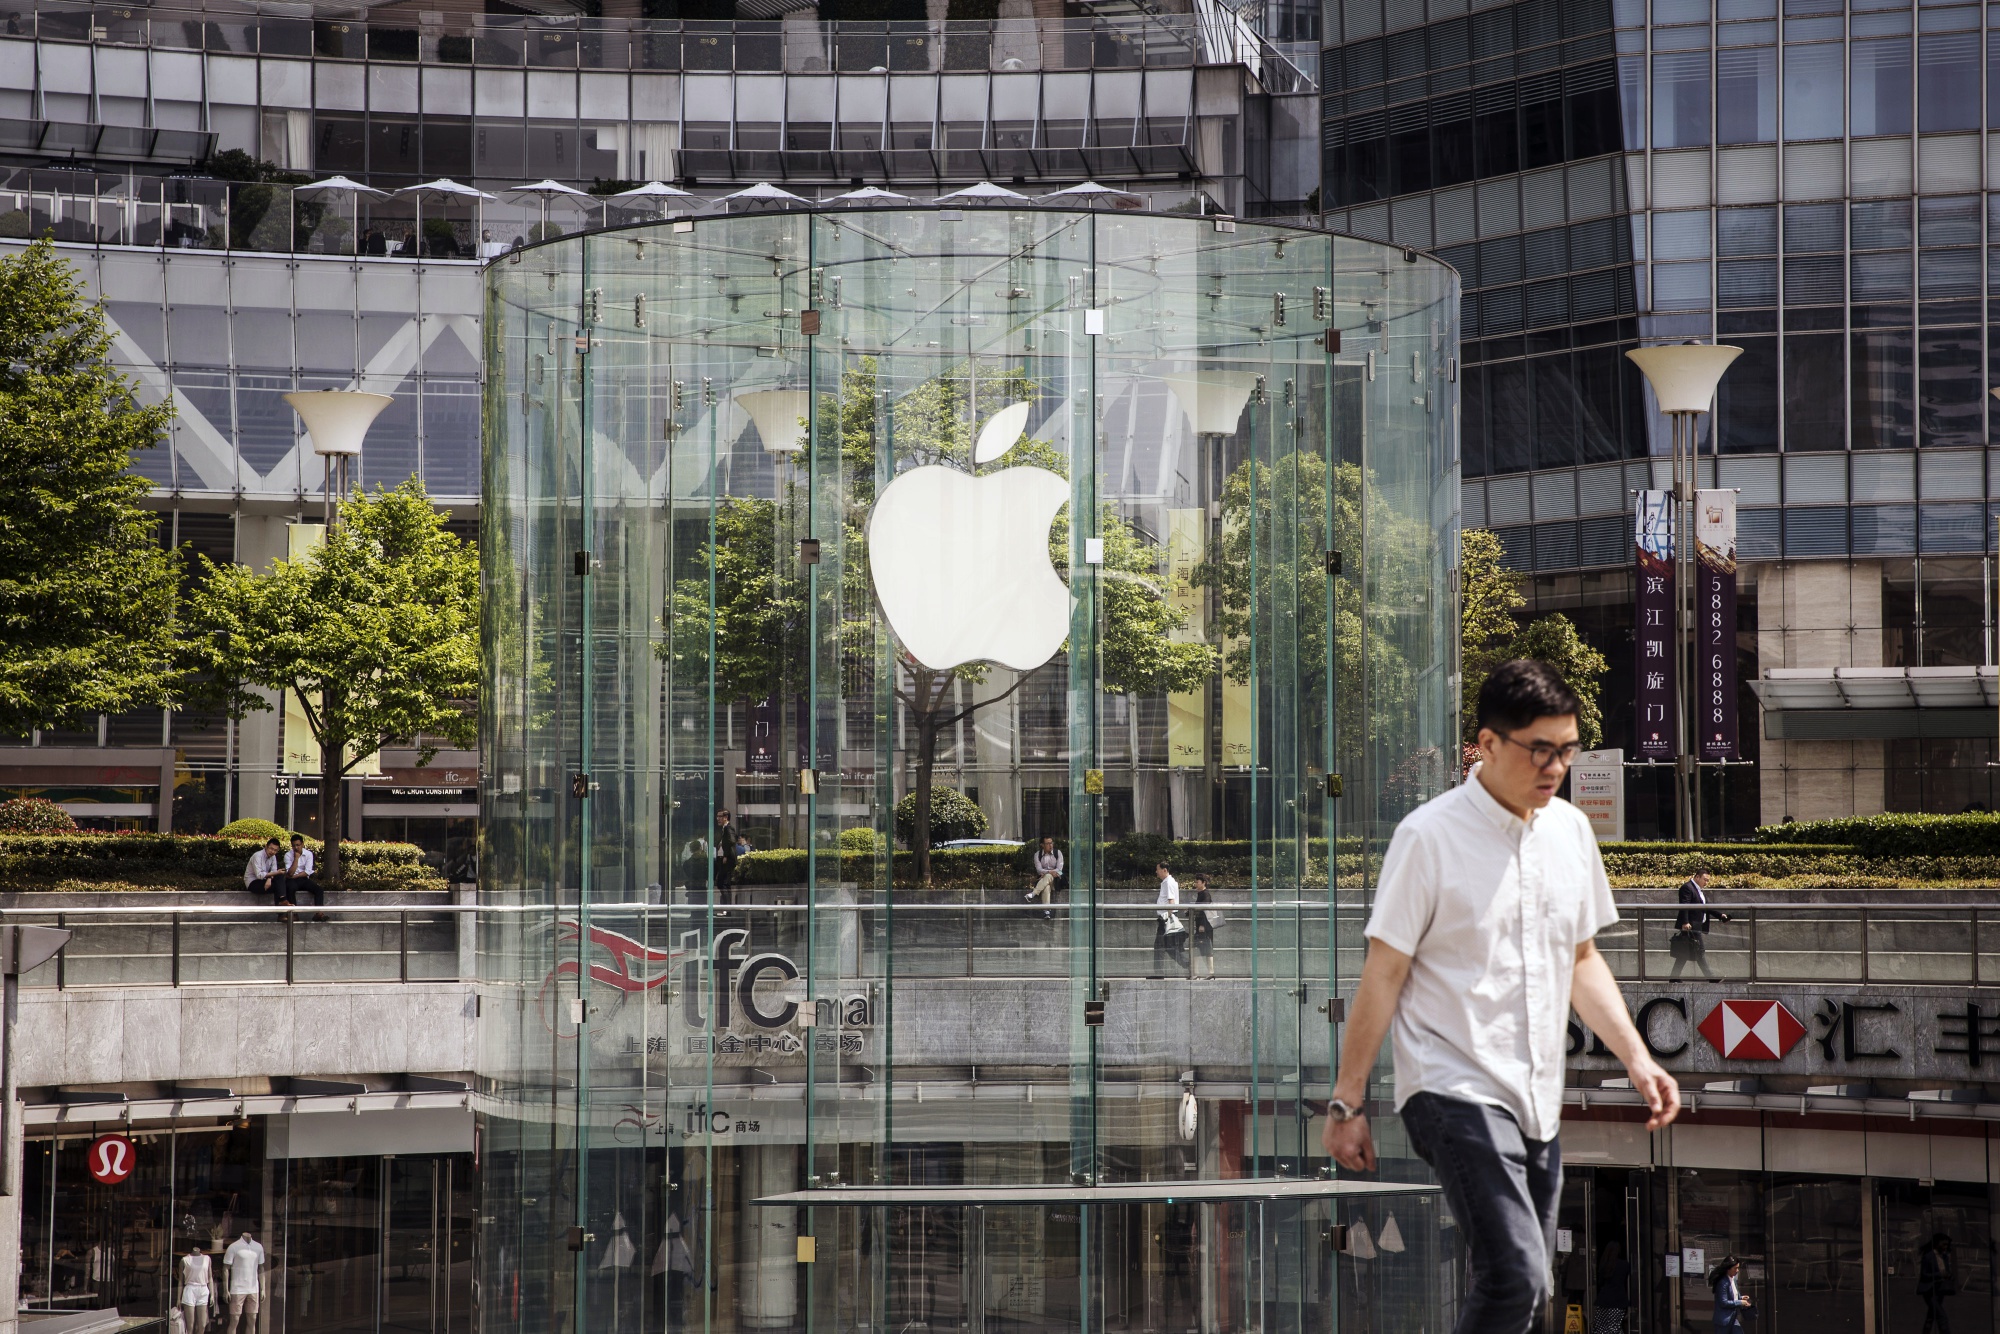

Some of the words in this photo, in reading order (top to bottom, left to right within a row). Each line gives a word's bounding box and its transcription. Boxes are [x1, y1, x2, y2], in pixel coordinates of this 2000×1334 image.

[1646, 576, 1665, 722] 滨江凯旋门
[280, 787, 318, 795] COSTANTIN
[445, 771, 459, 782] ifc
[680, 928, 799, 1029] ifc
[687, 1103, 730, 1134] ifc
[735, 1120, 761, 1133] 商场
